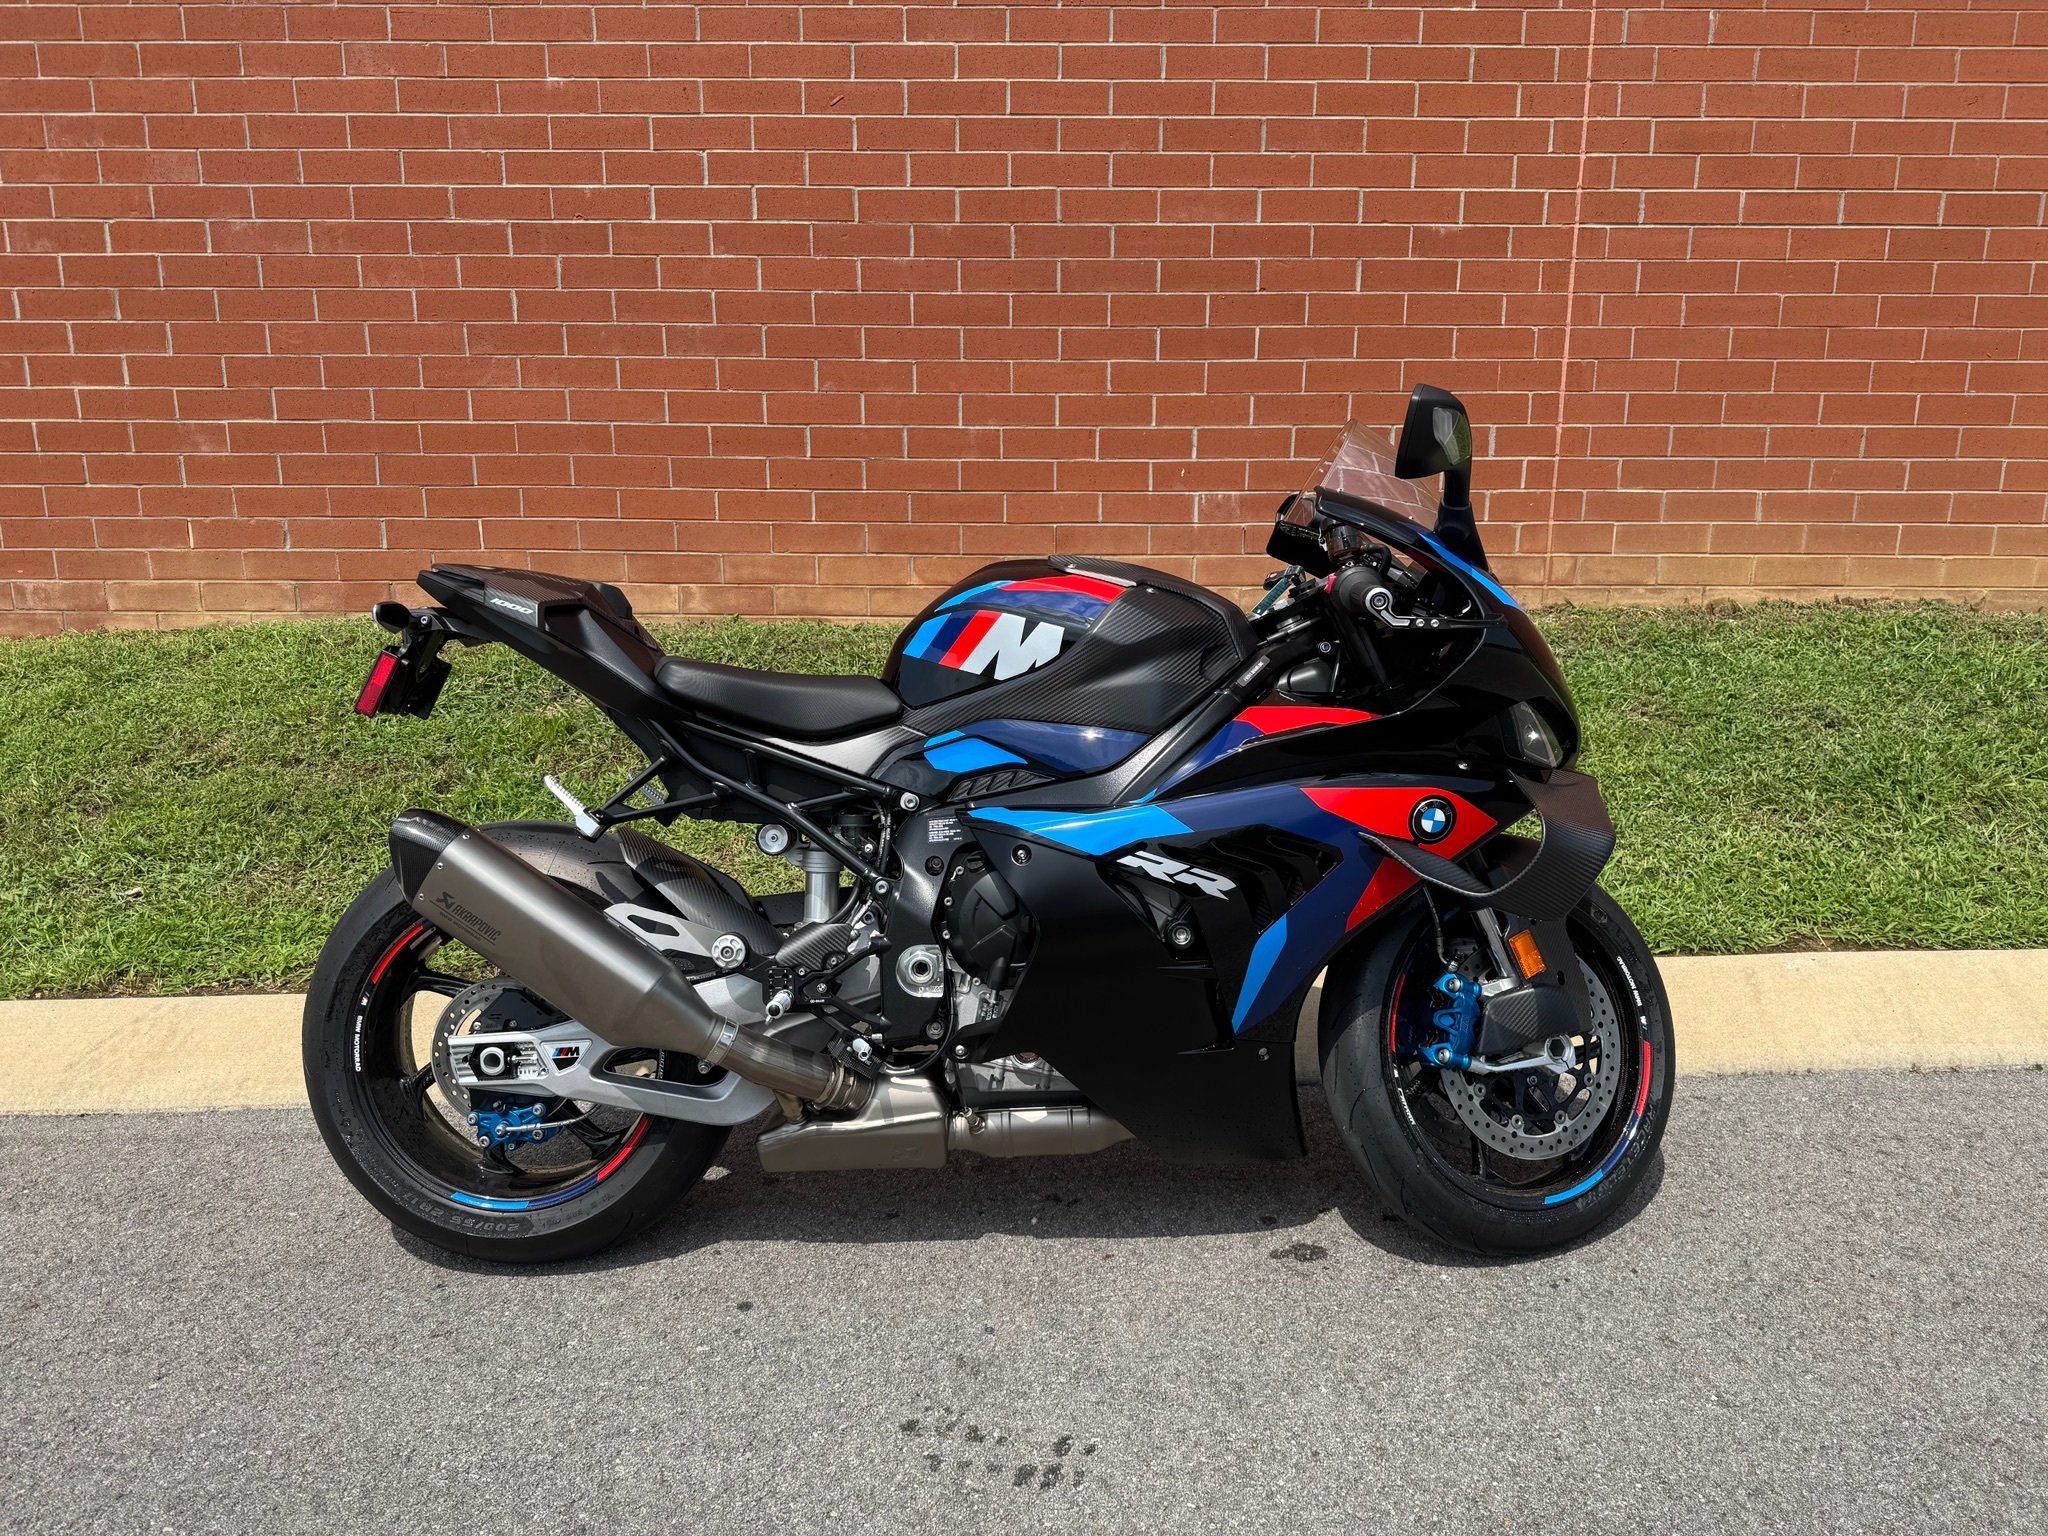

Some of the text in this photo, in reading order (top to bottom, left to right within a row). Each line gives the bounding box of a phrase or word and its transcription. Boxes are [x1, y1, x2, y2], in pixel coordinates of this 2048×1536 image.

[490, 597, 535, 615] 1000
[1419, 800, 1452, 816] BMW
[1116, 850, 1237, 900] RR
[354, 1015, 363, 1033] BMW
[353, 1033, 362, 1072] MOTORRAD
[450, 1215, 520, 1232] 200/55
